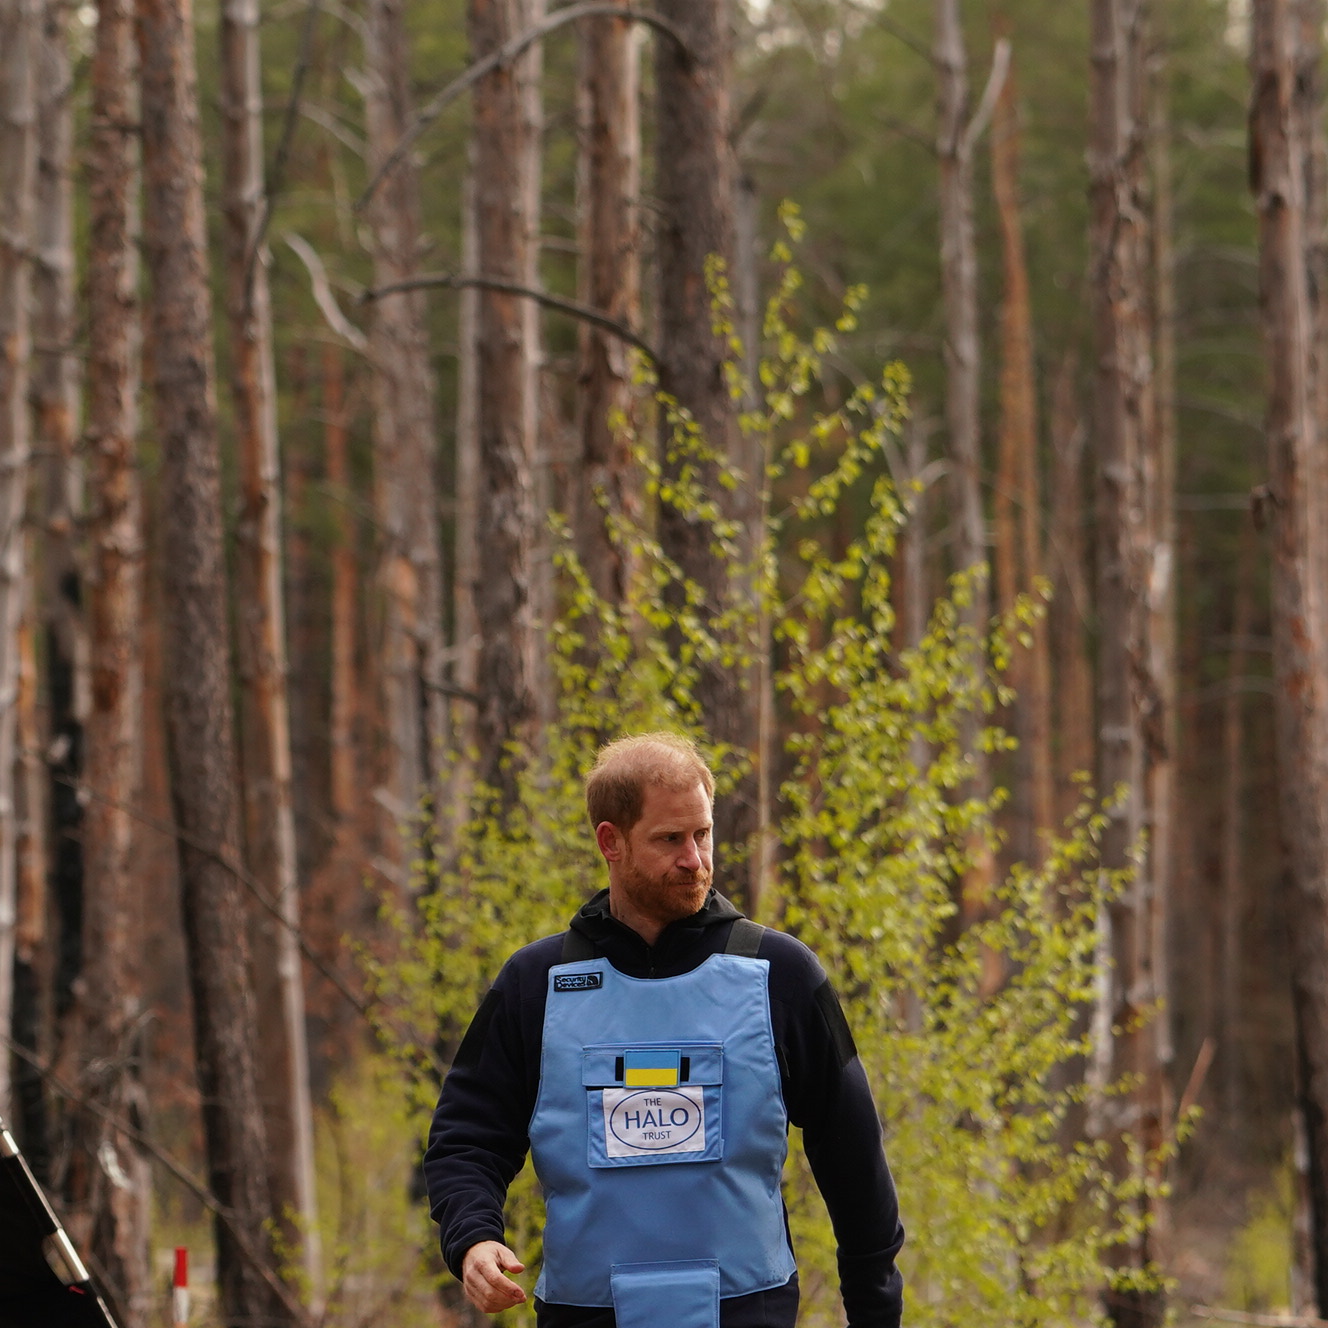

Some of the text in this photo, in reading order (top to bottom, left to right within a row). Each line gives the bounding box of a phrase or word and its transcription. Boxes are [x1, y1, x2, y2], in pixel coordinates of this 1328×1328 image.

[643, 1098, 661, 1106] THE
[625, 1107, 689, 1129] HALO
[642, 1131, 671, 1141] TRUST
